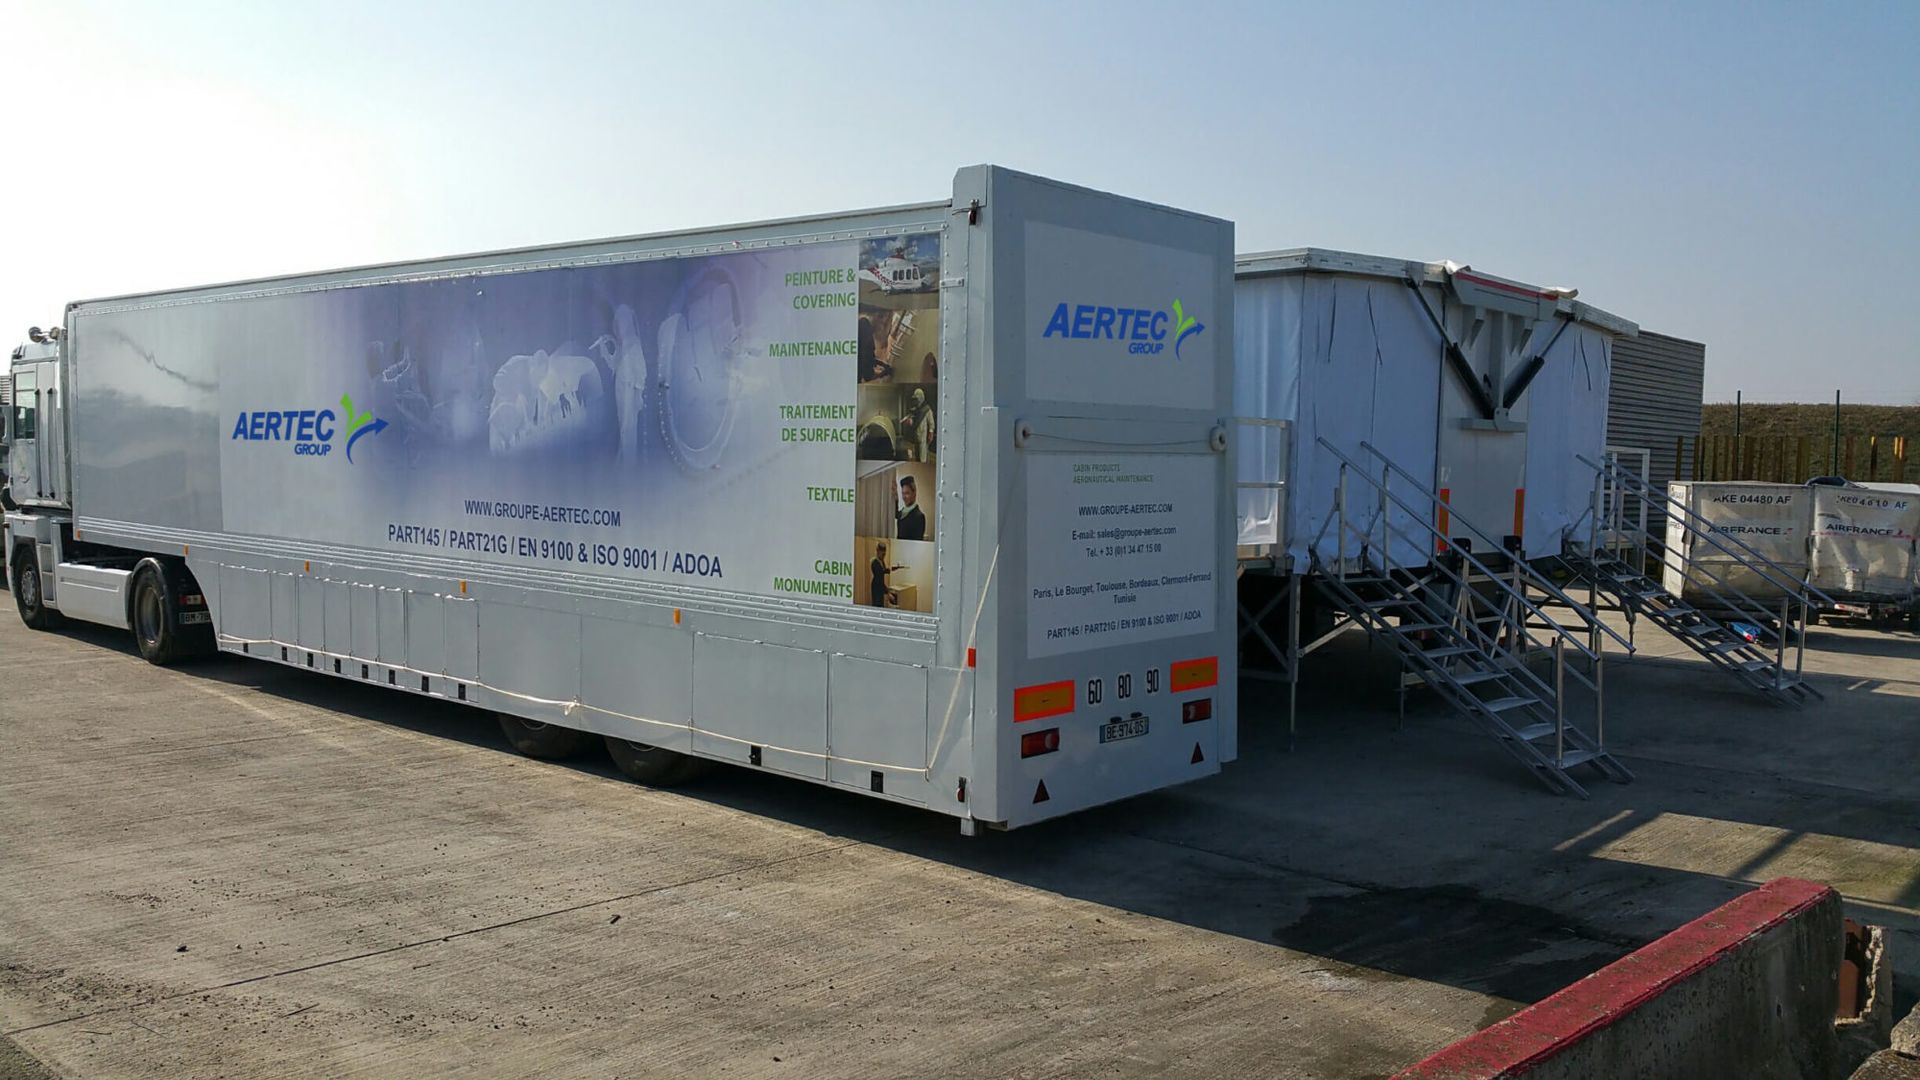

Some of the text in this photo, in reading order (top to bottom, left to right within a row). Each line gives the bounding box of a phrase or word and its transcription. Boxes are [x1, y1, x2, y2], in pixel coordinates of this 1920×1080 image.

[785, 268, 856, 287] PEINTURE &
[793, 292, 856, 310] COVERING
[1042, 303, 1168, 340] AERTEC
[769, 340, 857, 357] MAINTENANCE
[1128, 342, 1164, 354] GROUP
[779, 405, 856, 419] TRAITEMENT
[232, 409, 335, 442] AERTEC
[782, 428, 855, 442] DE SURFACE
[294, 443, 331, 456] GROUP
[807, 487, 854, 503] TEXTILE
[1740, 495, 1773, 504] 04480
[1776, 495, 1792, 504] AF
[1078, 503, 1173, 516] WWW.GROUPE-AERTEC.COM
[1894, 501, 1908, 509] AF
[464, 500, 621, 527] WWW.GROUPE-AERTEC.COM
[1072, 526, 1176, 540] E-mail: sales@groupe-aertec.com
[1708, 526, 1781, 535] ARFRANCE
[1826, 523, 1894, 535] AIRFRANCE
[388, 524, 722, 578] PART145 / PART21G / EN 9100 & ISO 9001 / ADOA
[1105, 546, 1113, 556] 33
[814, 560, 852, 576] CABIN
[773, 577, 852, 598] MONUMENTS
[1033, 588, 1053, 599] Paris,
[1055, 588, 1064, 597] Le
[1161, 572, 1211, 586] Clermont-Ferrand
[1113, 593, 1136, 604] Tunisie
[1047, 627, 1079, 639] PART145
[1084, 622, 1116, 634] PART21G
[1121, 619, 1130, 629] EN
[1131, 617, 1146, 628] 9100
[1148, 616, 1152, 625] &
[1153, 615, 1165, 624] ISO
[1165, 613, 1179, 623] 9001
[1184, 610, 1201, 620] ADOA
[1088, 669, 1159, 705] 60 80 90
